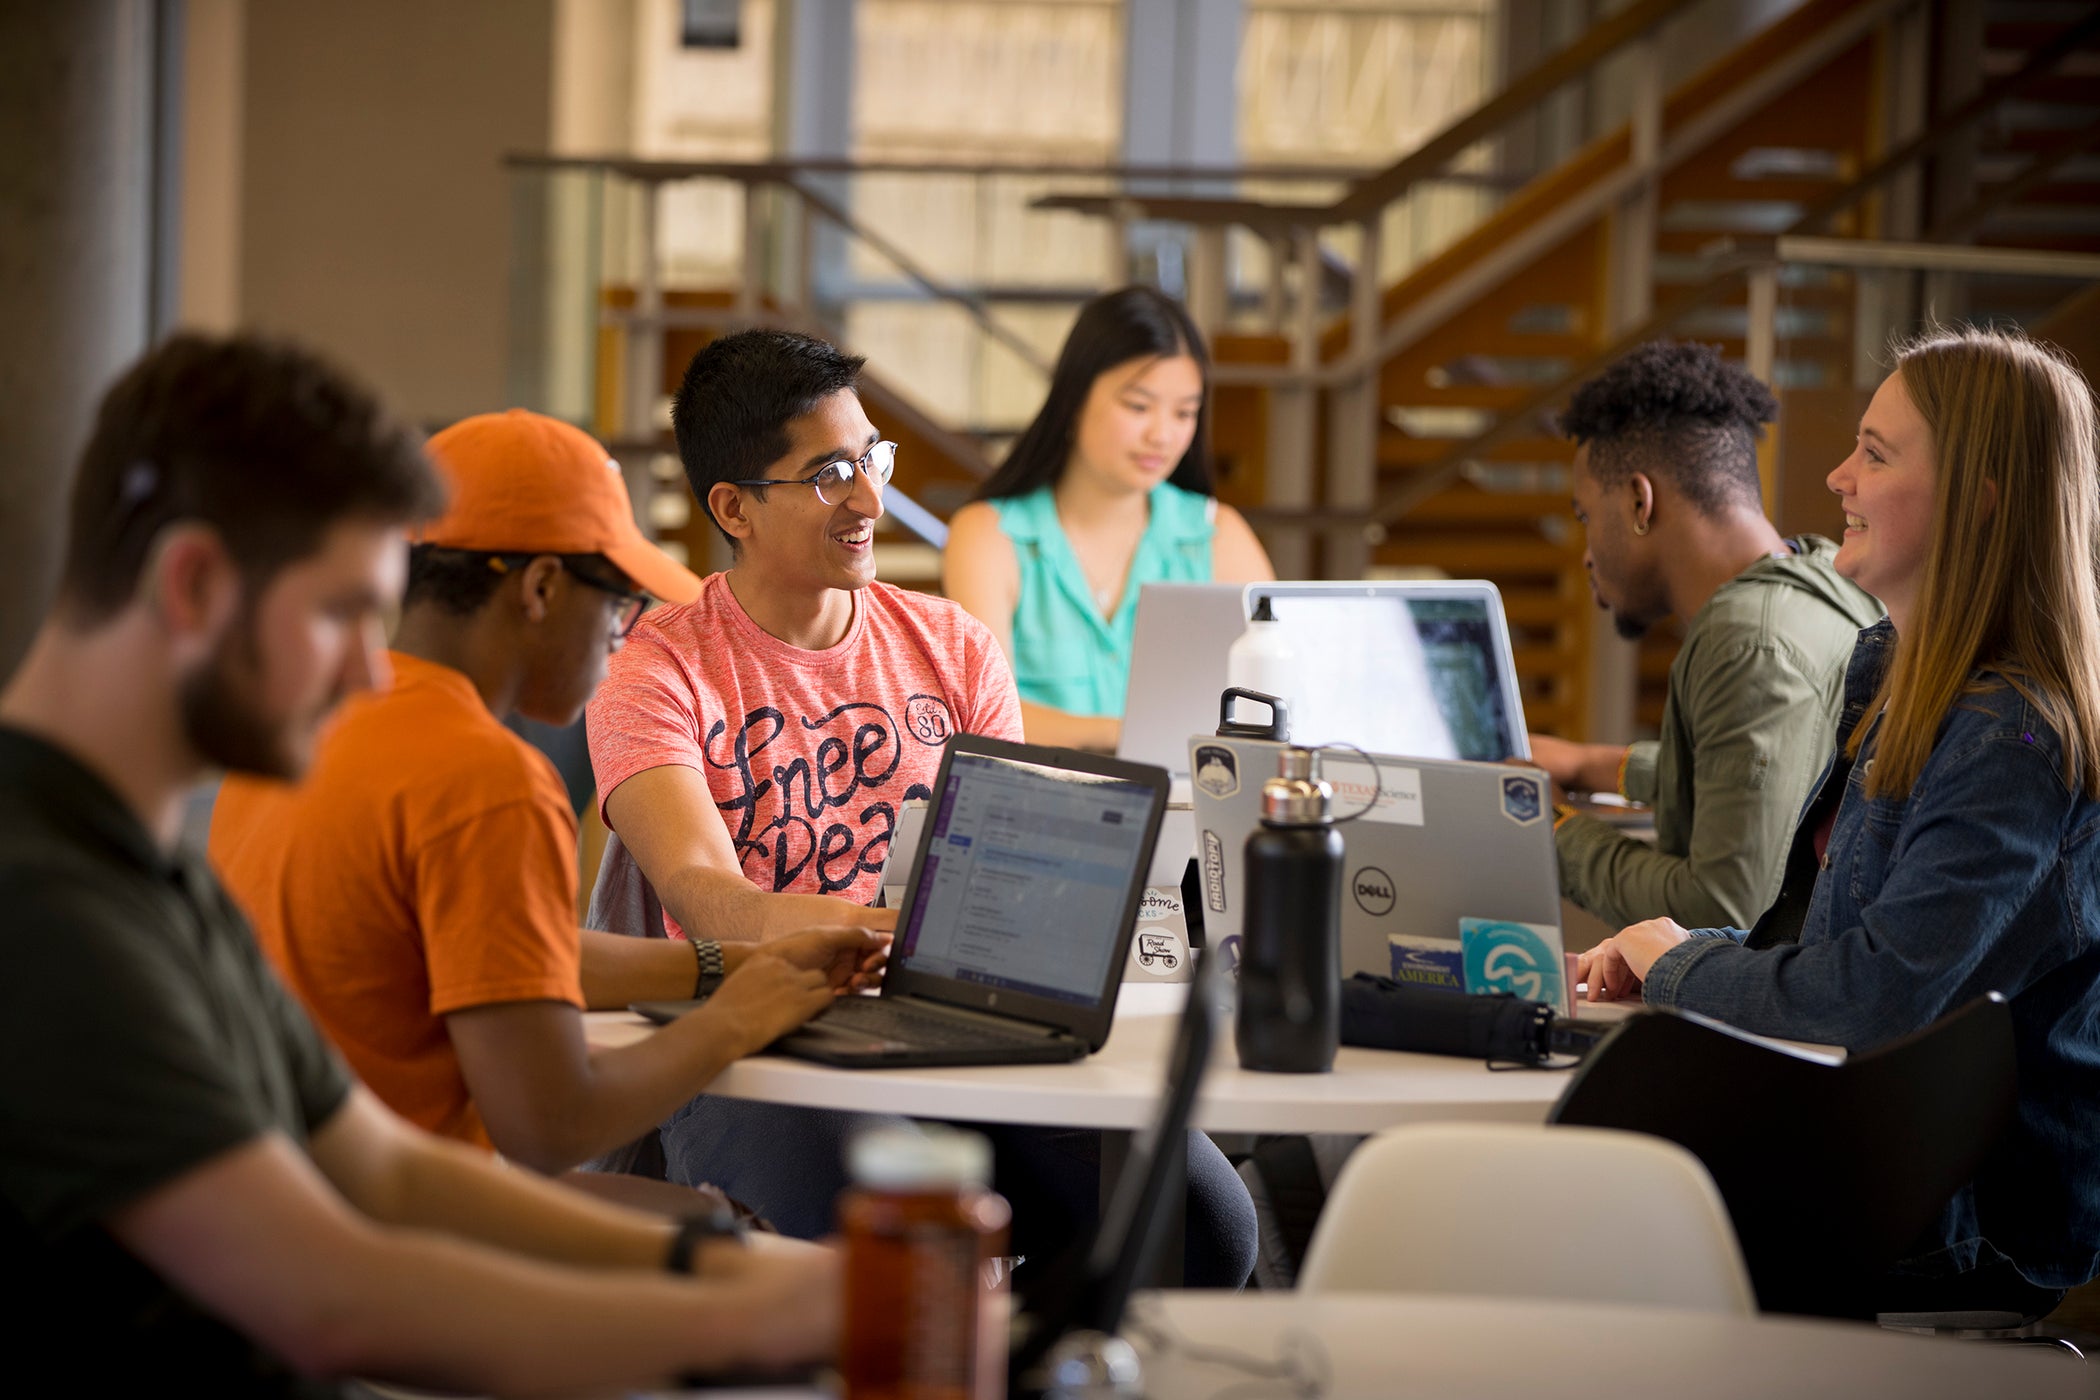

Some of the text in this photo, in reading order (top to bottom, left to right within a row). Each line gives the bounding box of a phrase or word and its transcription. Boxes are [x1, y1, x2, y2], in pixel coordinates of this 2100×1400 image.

[917, 714, 945, 738] 80
[704, 702, 901, 851] Free
[1357, 883, 1391, 898] DELL
[1397, 968, 1460, 988] AMERICA
